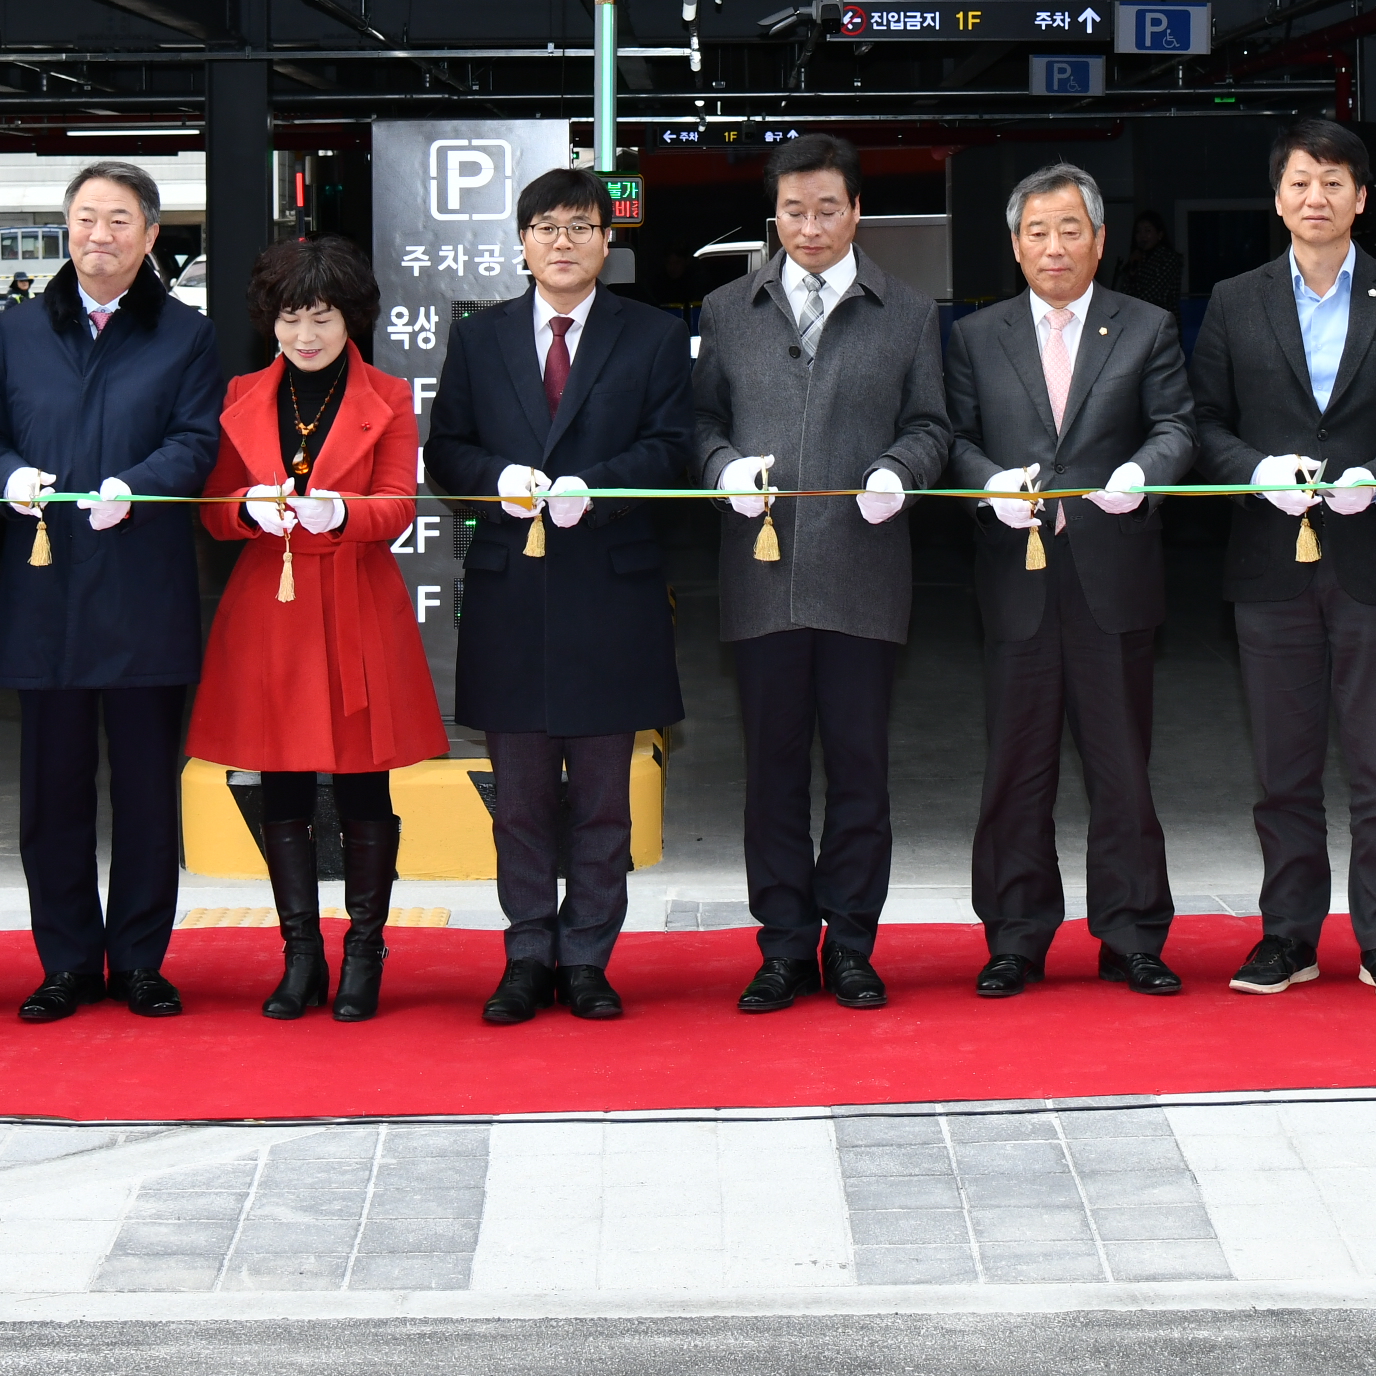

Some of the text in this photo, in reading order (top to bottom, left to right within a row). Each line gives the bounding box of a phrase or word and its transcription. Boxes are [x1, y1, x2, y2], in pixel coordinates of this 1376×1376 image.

[870, 11, 1071, 30] 진입금지 1F 주차
[1145, 12, 1168, 47] P
[1053, 63, 1072, 90] P
[679, 131, 699, 143] 주차
[724, 131, 738, 143] 1F
[447, 150, 495, 210] P
[607, 182, 639, 199] 불가
[387, 305, 439, 350] 옥상
[417, 585, 441, 622] F
